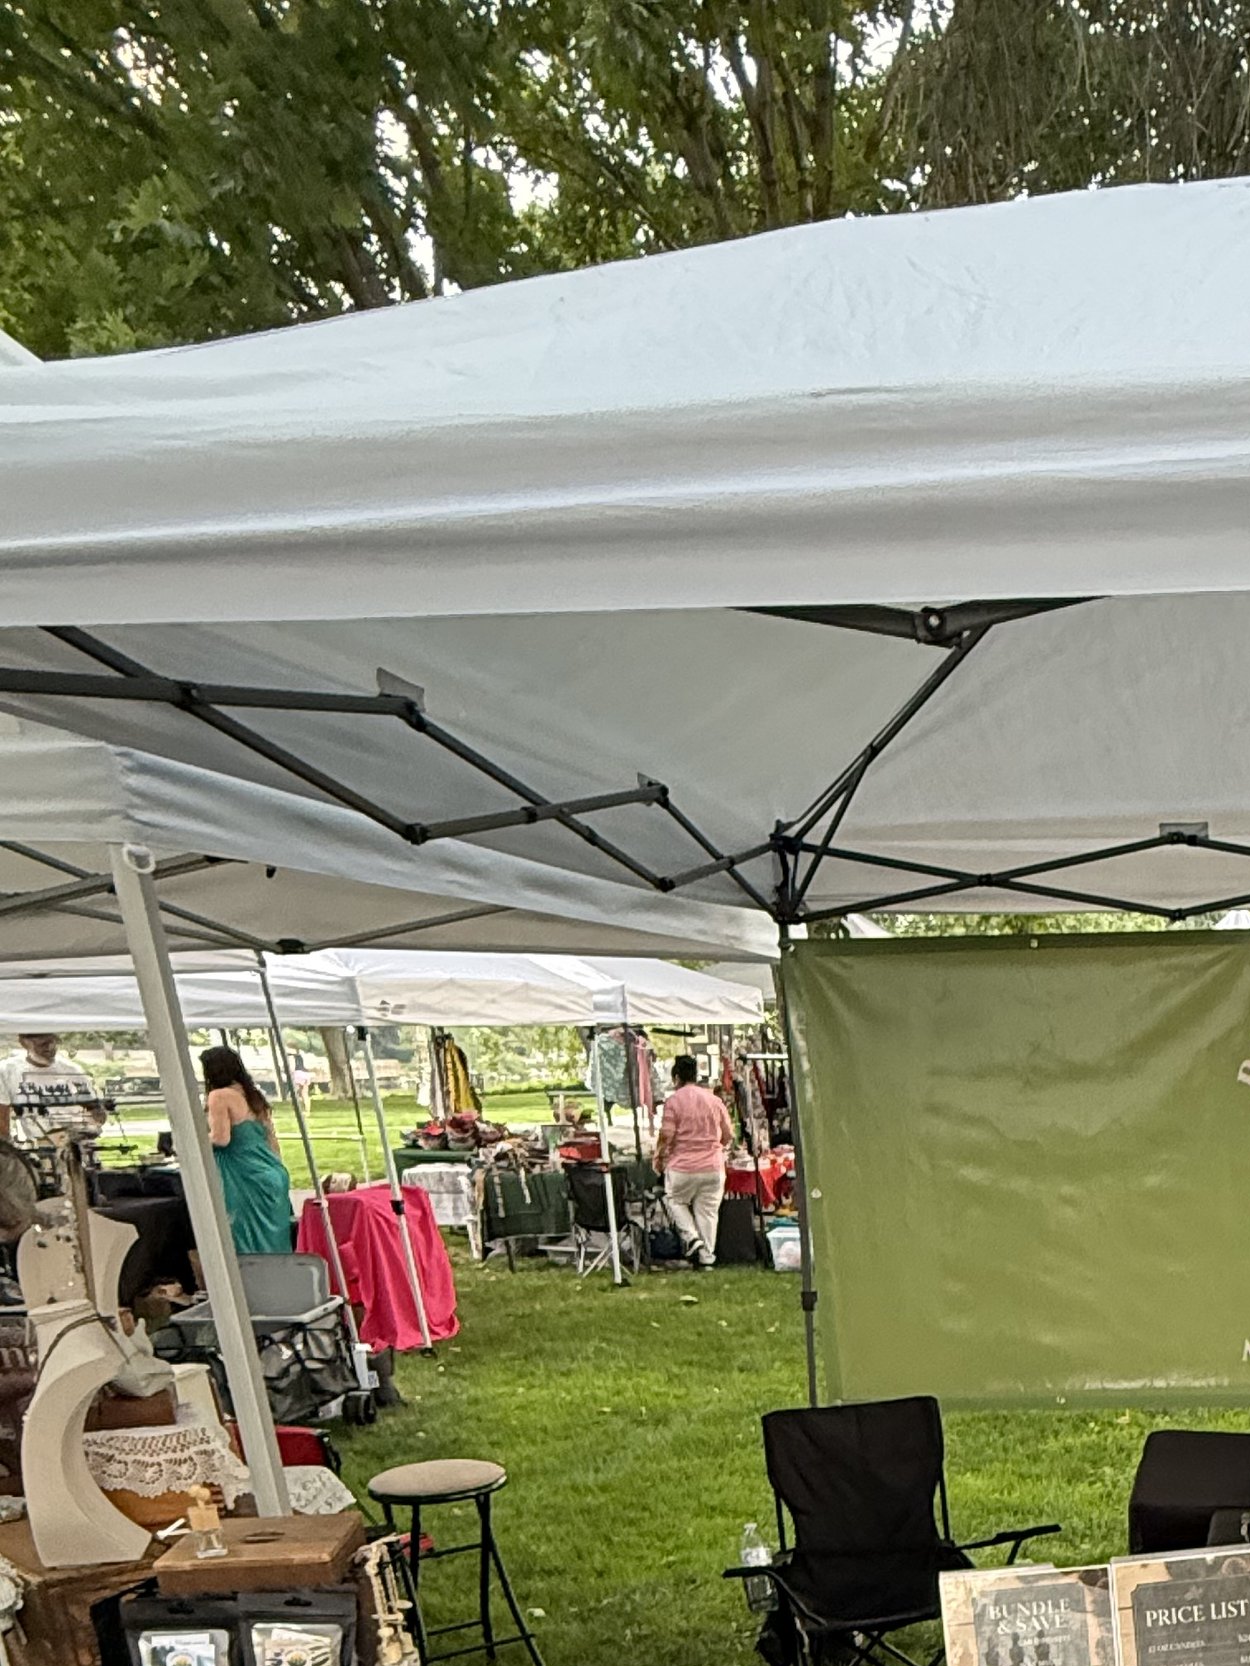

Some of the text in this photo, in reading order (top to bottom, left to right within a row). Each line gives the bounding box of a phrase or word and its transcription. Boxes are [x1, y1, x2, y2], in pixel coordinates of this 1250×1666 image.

[988, 1598, 1070, 1620] BUNDLE
[1145, 1599, 1249, 1627] PRICE LIST
[997, 1614, 1067, 1634] & SAVE
